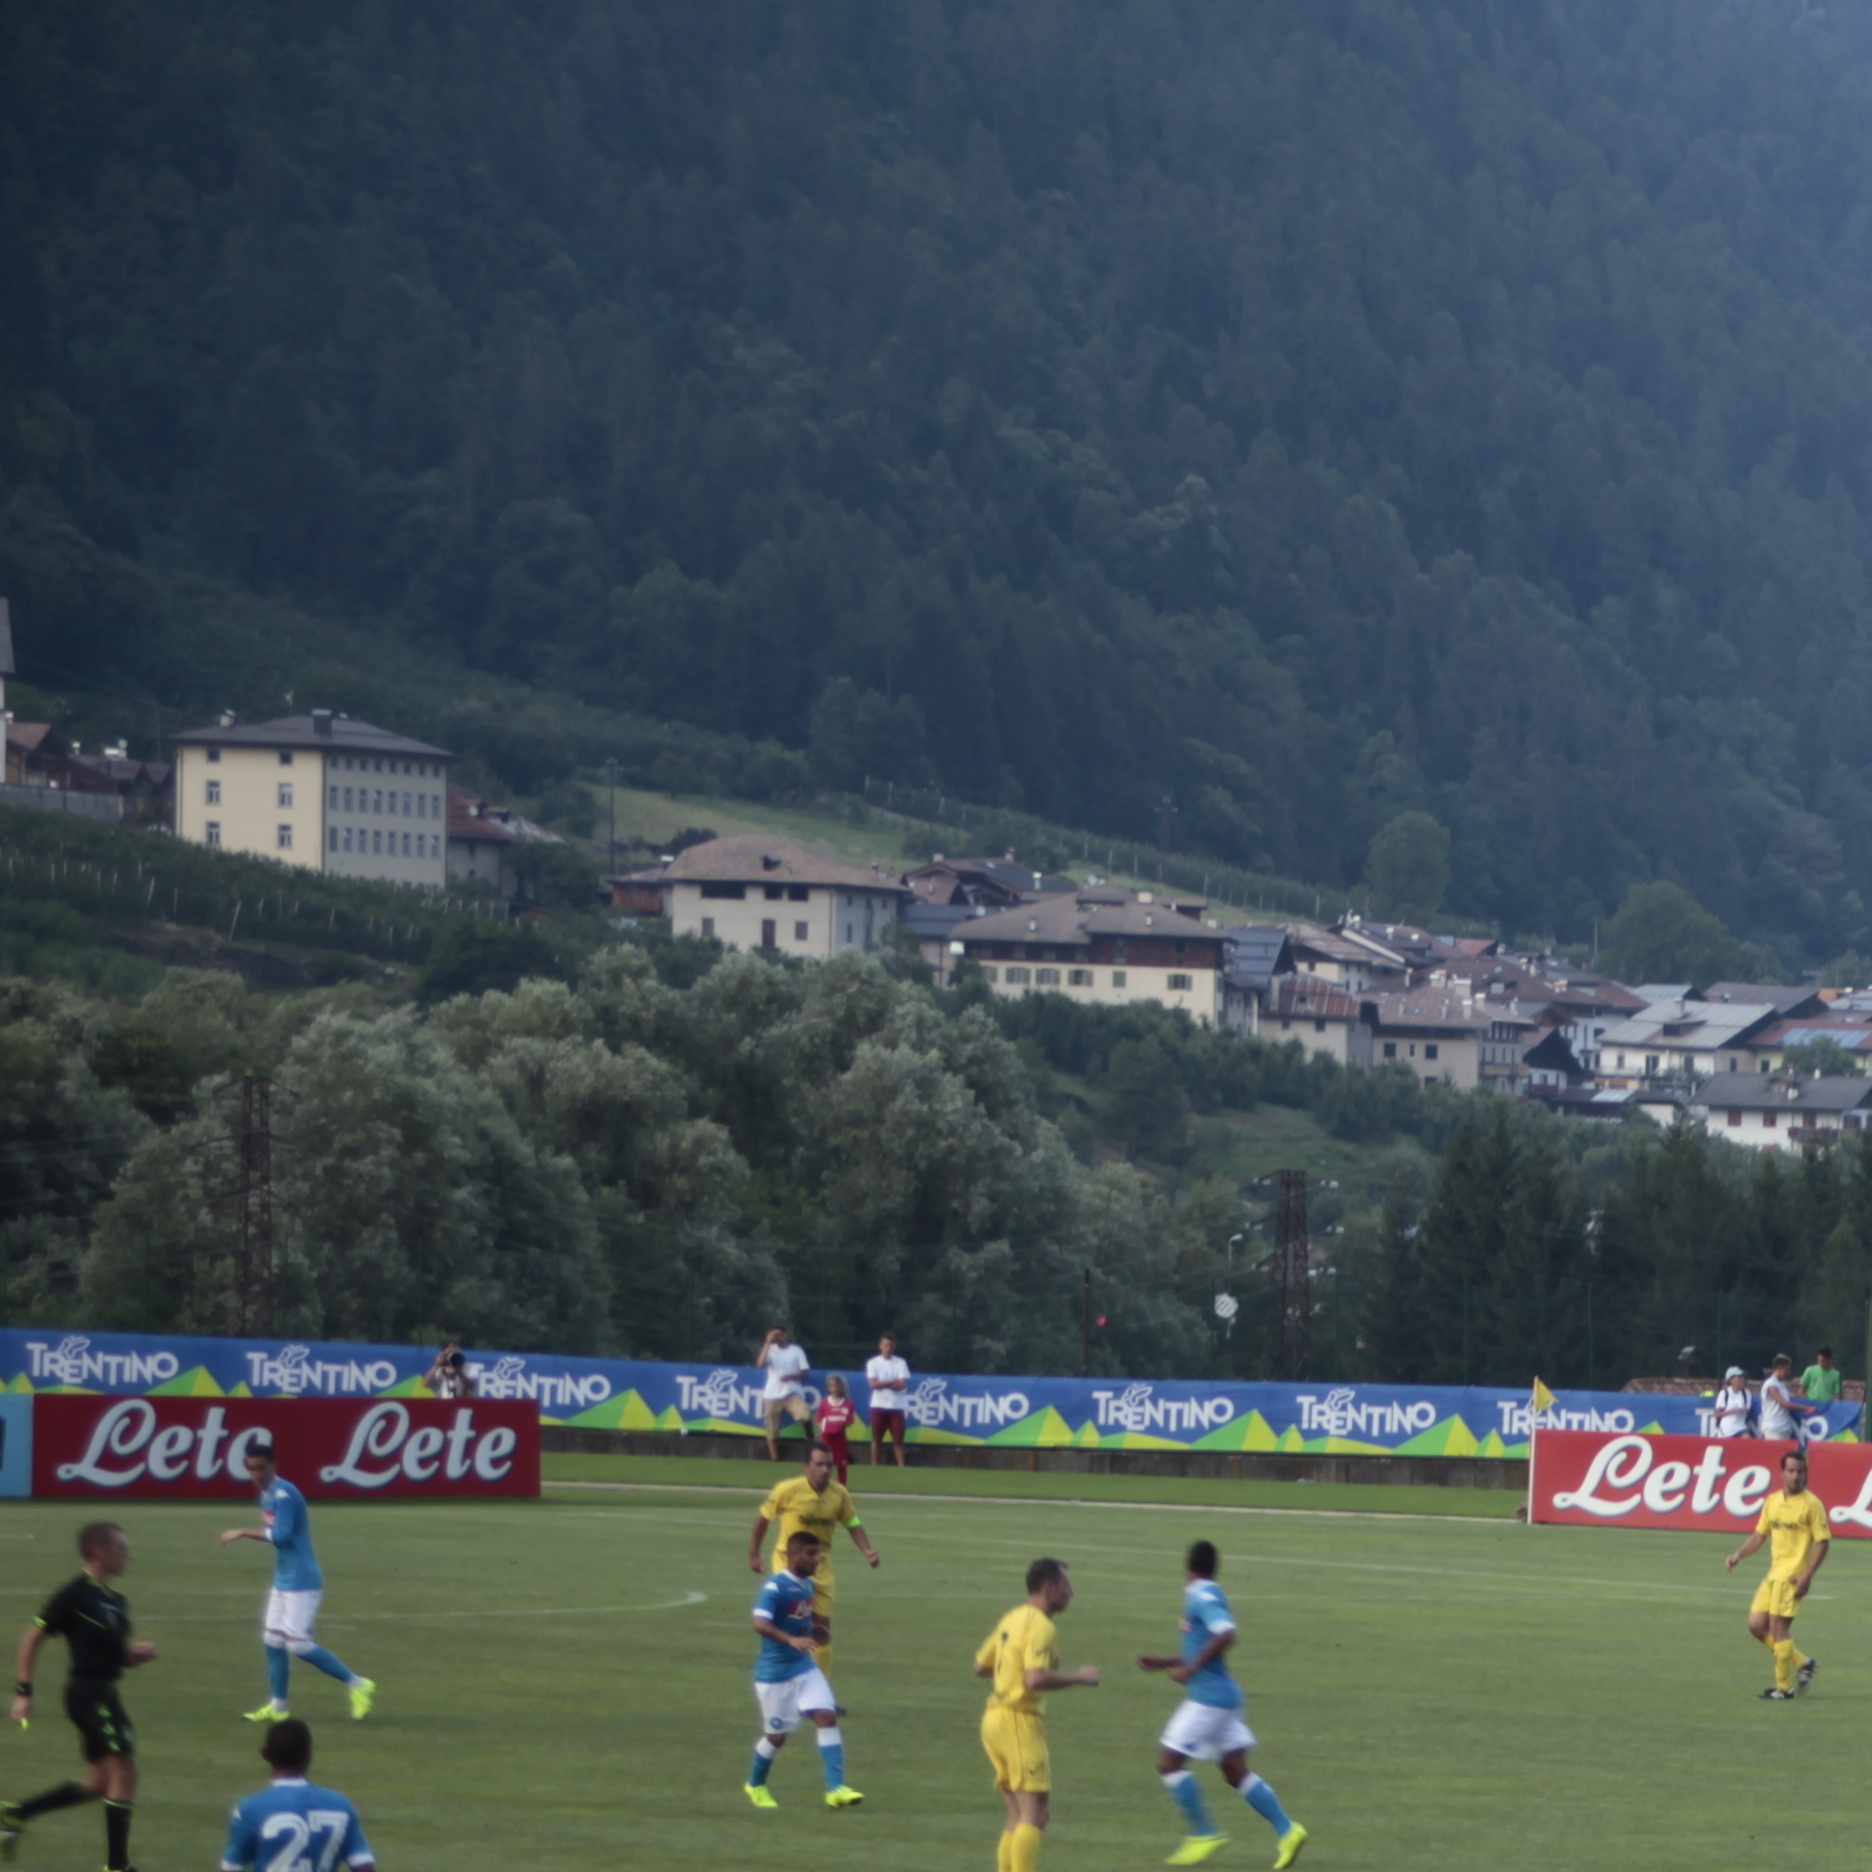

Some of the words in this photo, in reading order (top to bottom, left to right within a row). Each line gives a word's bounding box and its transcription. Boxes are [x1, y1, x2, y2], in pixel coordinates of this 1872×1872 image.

[26, 1342, 179, 1386] TRENTINO
[246, 1352, 397, 1394] TRENTINO
[676, 1376, 821, 1419] TRENTO
[902, 1388, 1030, 1427] RENTINO
[1093, 1391, 1235, 1432] TRENTINO
[1296, 1396, 1436, 1437] TRENTINO
[320, 1402, 517, 1488] Lete
[1552, 1435, 1772, 1517] Lete
